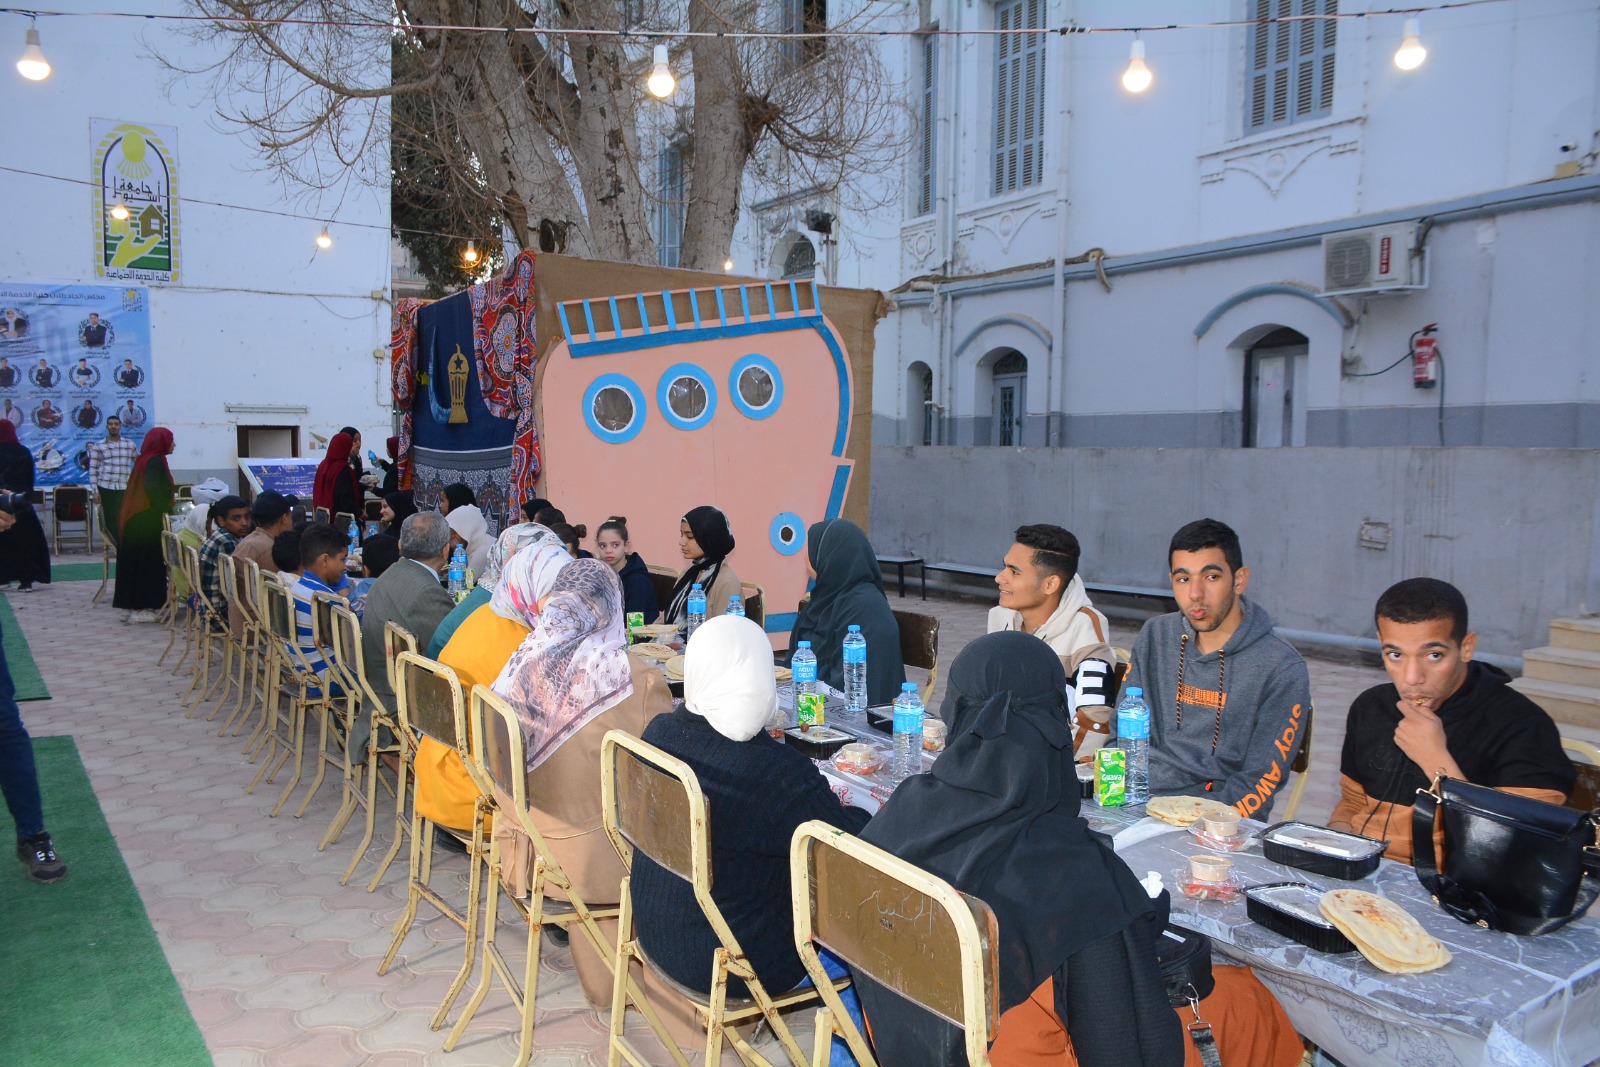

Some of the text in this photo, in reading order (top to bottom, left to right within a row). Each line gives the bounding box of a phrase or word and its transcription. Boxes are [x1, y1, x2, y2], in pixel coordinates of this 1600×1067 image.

[112, 176, 160, 202] أسيوط
[120, 178, 153, 194] جامعة
[136, 270, 155, 281] الخدمة
[156, 271, 170, 284] كلية
[1075, 660, 1108, 706] E
